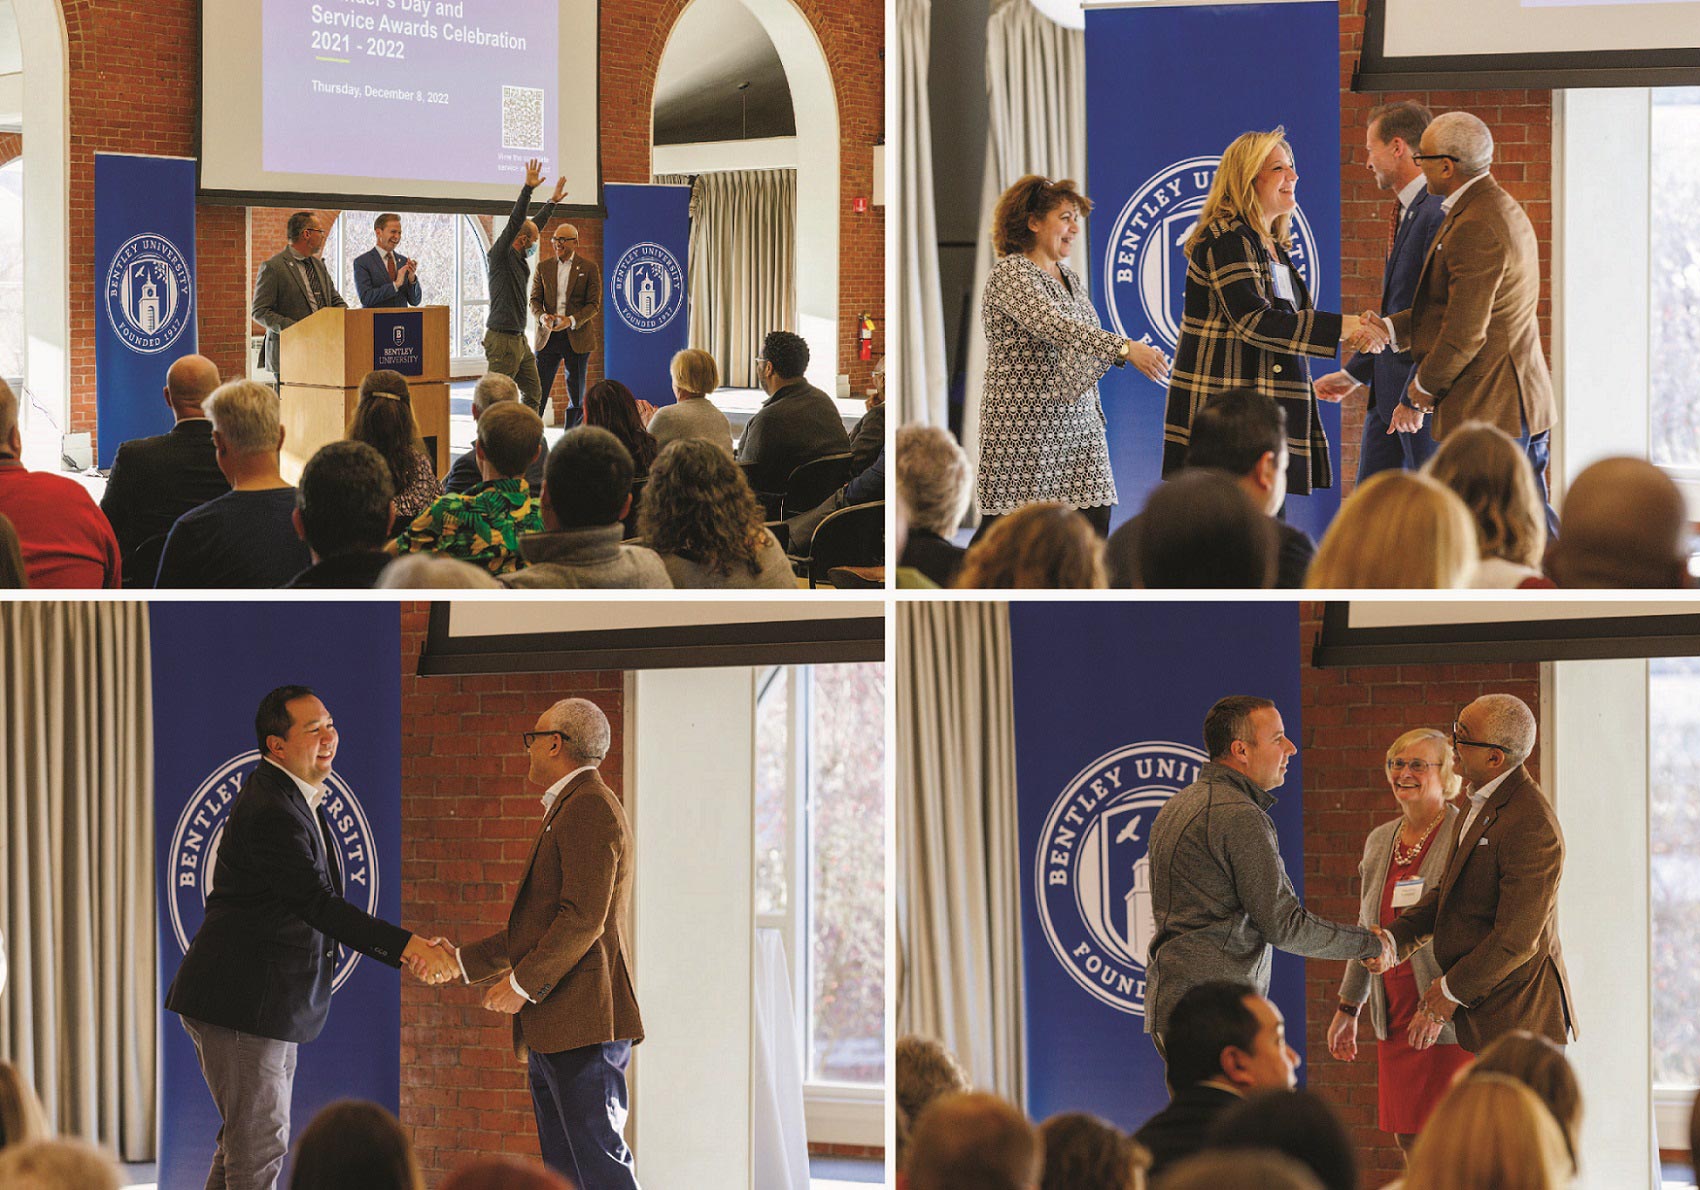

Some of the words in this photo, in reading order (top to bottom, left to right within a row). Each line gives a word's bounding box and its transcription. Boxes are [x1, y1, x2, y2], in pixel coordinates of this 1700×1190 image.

[402, 0, 431, 17] Day
[436, 1, 463, 18] and
[312, 5, 374, 30] Service
[379, 14, 438, 39] Awards
[443, 22, 526, 50] Celebration
[312, 30, 349, 52] 2021
[367, 37, 404, 59] 2022
[312, 80, 362, 98] Thursday,
[365, 85, 414, 101] December
[416, 90, 425, 103] 8,
[428, 91, 449, 104] 2022
[1117, 177, 1182, 283] BENTLEY
[111, 243, 138, 297] BENTLEY
[142, 240, 188, 294] UNIVERSITY
[616, 249, 639, 289] BENTLEY
[642, 247, 680, 289] UNIVERSITY
[119, 322, 161, 347] FOUNDED
[164, 318, 180, 341] 1917
[622, 307, 656, 328] FOUNDED
[379, 355, 418, 365] UNIVERSITY
[384, 347, 413, 356] BENTLEY
[179, 771, 243, 888] BENTLEY
[320, 780, 367, 887] ERSITY
[1050, 766, 1122, 886] BENTLEY
[1072, 941, 1147, 998] FOUND
